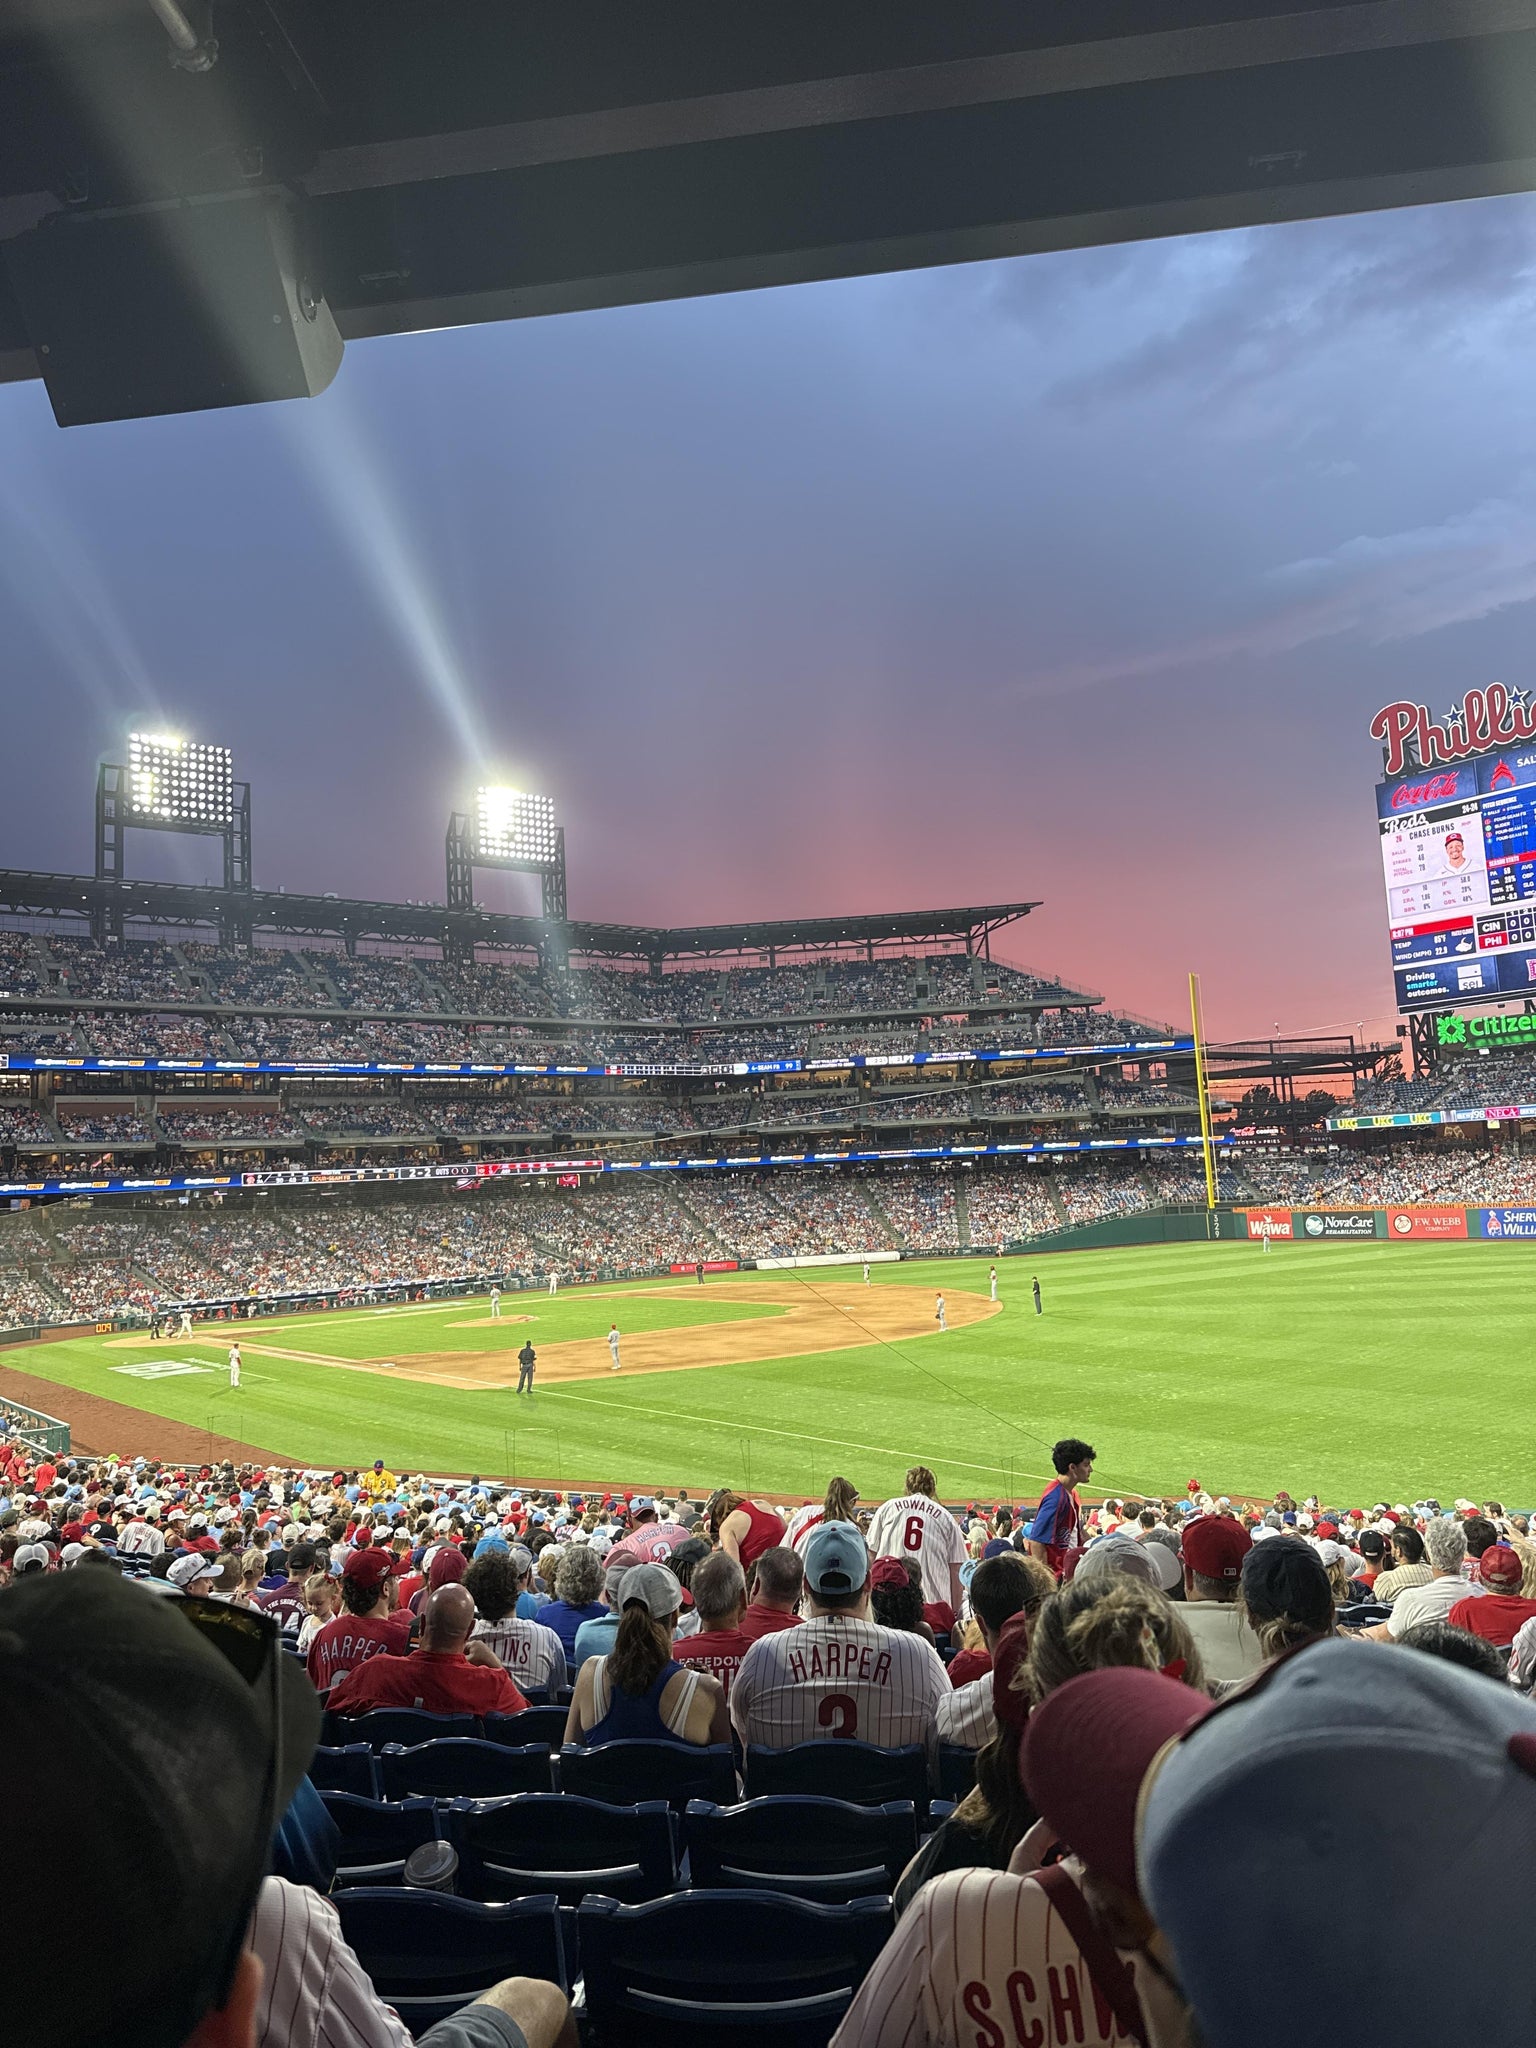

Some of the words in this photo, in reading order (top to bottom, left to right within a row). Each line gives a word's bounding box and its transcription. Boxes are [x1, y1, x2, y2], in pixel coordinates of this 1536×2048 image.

[1517, 755, 1536, 768] SAL
[1391, 770, 1460, 809] Coca-Cola
[1384, 813, 1429, 834] Reds
[1409, 828, 1430, 840] CHASE
[1432, 822, 1455, 835] BURNS
[1482, 920, 1500, 932] CIN
[1510, 919, 1516, 927] 0
[1523, 917, 1530, 925] 0
[1394, 941, 1411, 949] TEMP
[1484, 935, 1502, 947] PHI
[1511, 933, 1518, 941] 0
[1525, 931, 1531, 939] 0
[1405, 972, 1435, 982] Driving
[1406, 980, 1438, 990] smarter
[1407, 987, 1450, 998] outcomes.
[1250, 1221, 1290, 1235] Wawa
[1324, 1216, 1373, 1228] NovaCare
[1432, 1216, 1461, 1226] WEBB
[894, 1499, 942, 1519] HOWARD
[903, 1515, 924, 1551] 6
[132, 1537, 142, 1551] 7
[789, 1642, 892, 1686] HARPER
